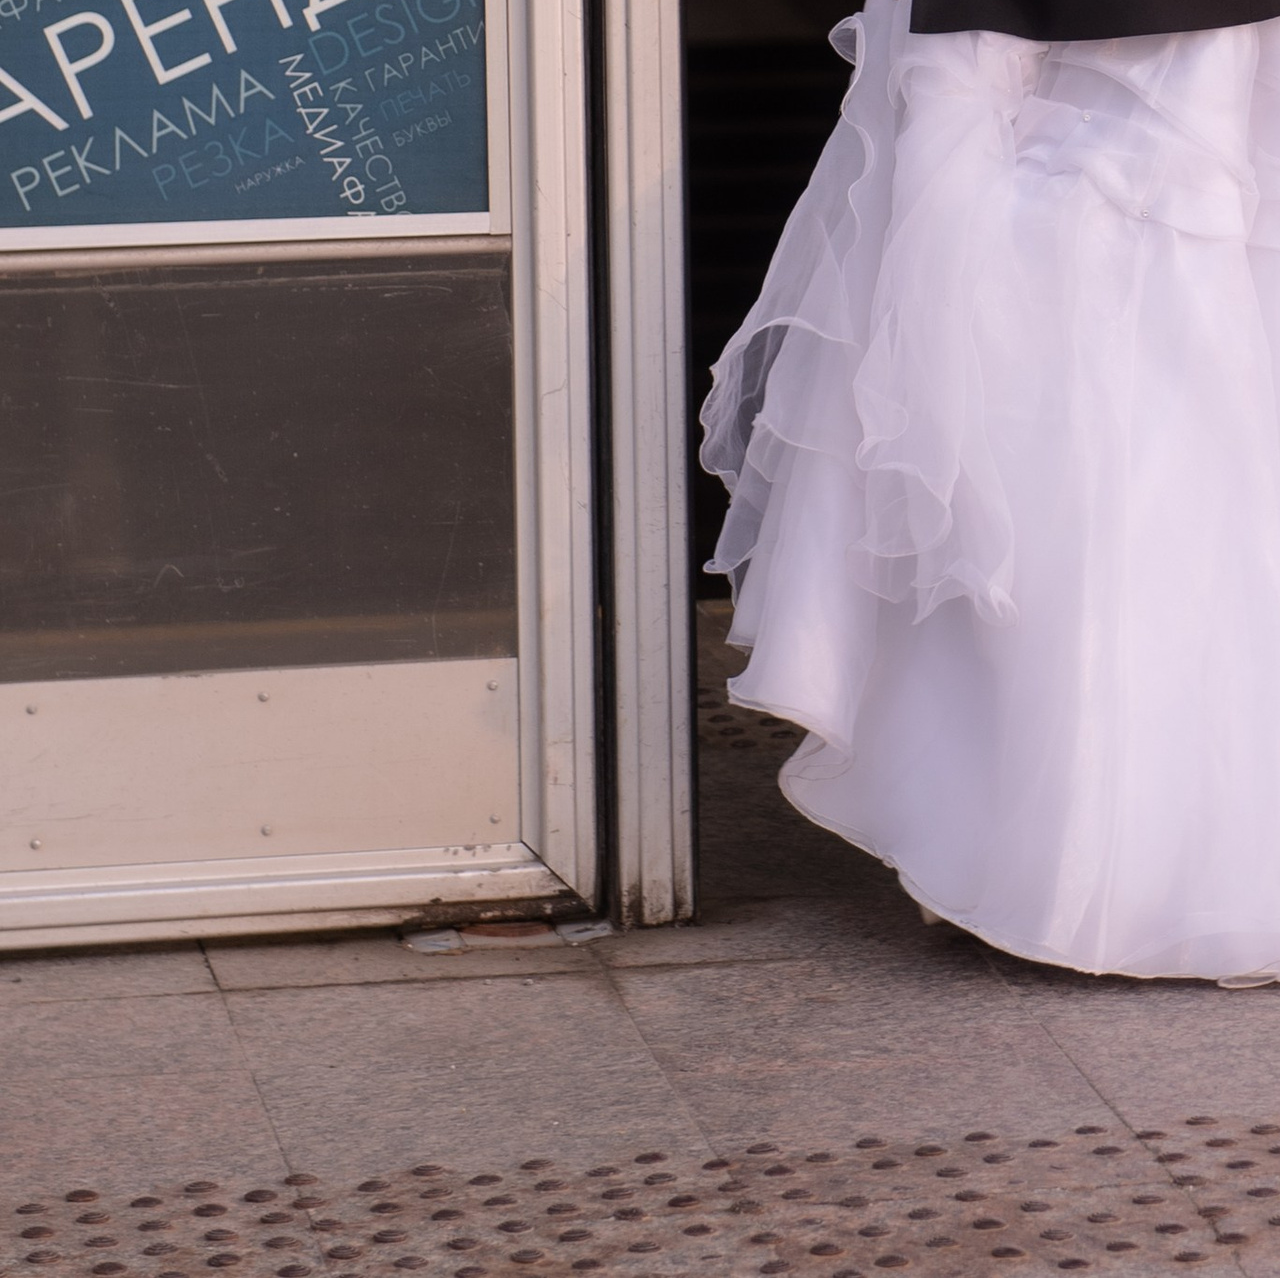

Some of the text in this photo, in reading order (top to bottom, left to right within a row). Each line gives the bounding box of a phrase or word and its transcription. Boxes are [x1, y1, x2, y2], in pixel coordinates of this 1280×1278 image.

[278, 53, 377, 217] МЕДИАФ
[379, 69, 472, 123] ПЕЧАТЬ
[392, 110, 453, 148] БУКВЫ
[9, 69, 276, 212] РЕКЛАМА
[151, 118, 295, 202] РЕЗКА
[235, 155, 306, 195] НАРУЖКА
[329, 77, 413, 215] КАЧЕСТВ
